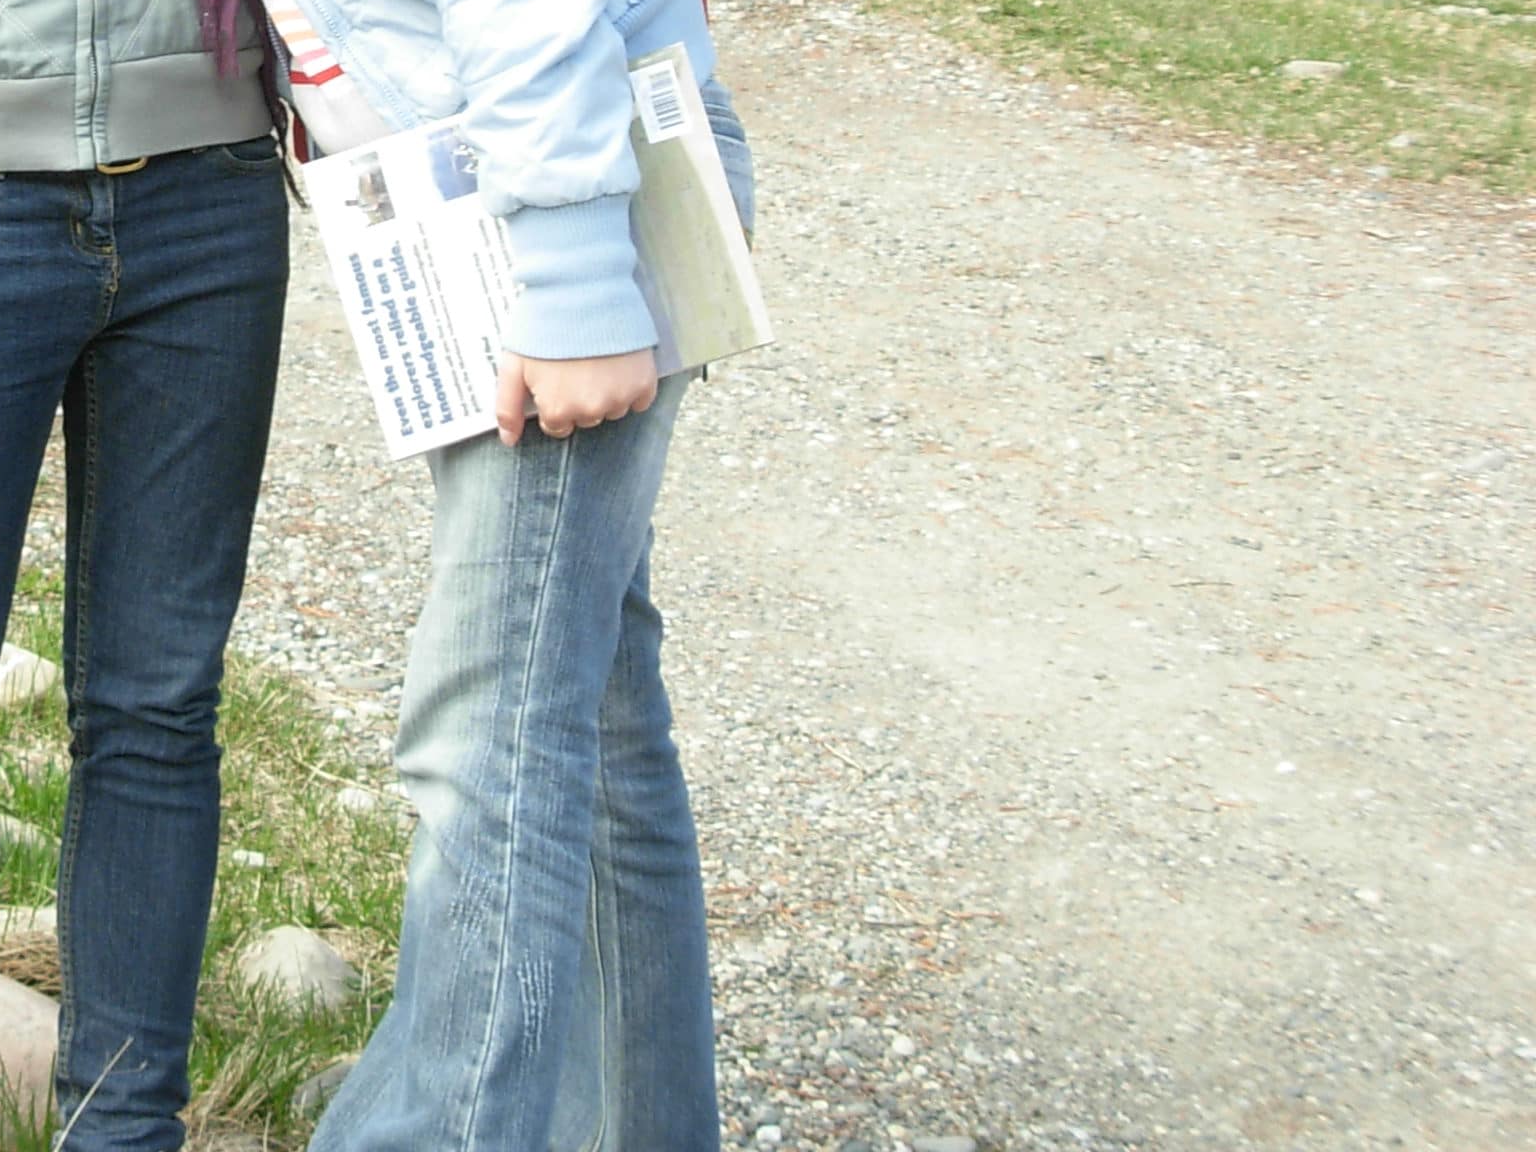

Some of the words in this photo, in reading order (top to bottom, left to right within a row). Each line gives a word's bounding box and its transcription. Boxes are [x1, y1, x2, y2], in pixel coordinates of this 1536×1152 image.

[349, 253, 374, 315] famous
[374, 258, 384, 268] a
[378, 273, 390, 294] on
[390, 239, 415, 291] guide.
[367, 319, 389, 360] most
[381, 299, 407, 346] relied
[385, 366, 399, 393] the
[405, 297, 453, 424] knowledgeable
[402, 352, 433, 429] explorers
[394, 397, 413, 436] Even
